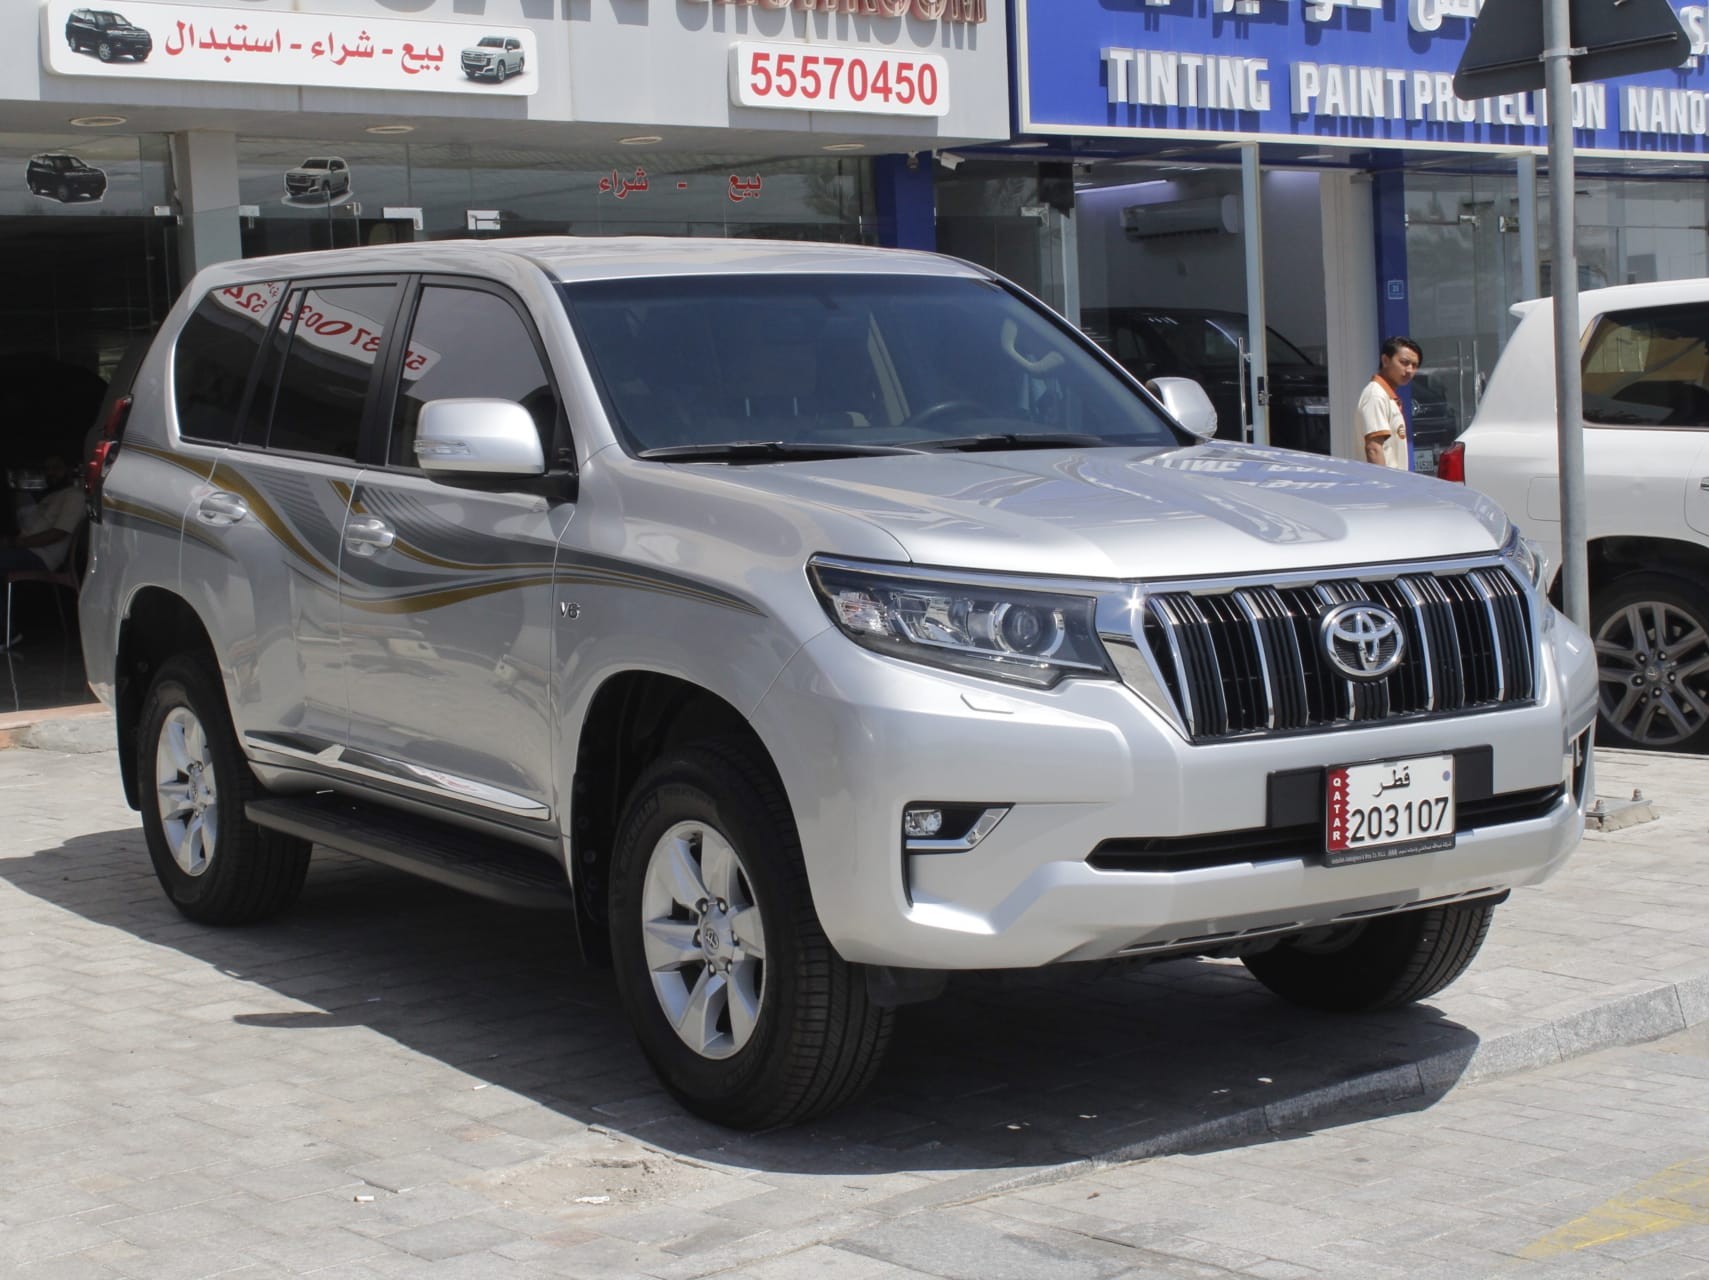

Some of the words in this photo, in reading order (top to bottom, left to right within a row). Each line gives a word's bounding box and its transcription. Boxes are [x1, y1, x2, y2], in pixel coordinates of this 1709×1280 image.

[165, 20, 281, 63] استبدال
[311, 30, 374, 65] شراء
[401, 42, 444, 74] بيع
[750, 52, 938, 105] 55570450
[1101, 47, 1270, 111] TINTING
[598, 167, 648, 199] شراء
[728, 174, 762, 202] بيع
[560, 601, 580, 620] V6
[1372, 766, 1410, 798] قطر
[1332, 777, 1342, 841] QATAR
[1350, 796, 1449, 842] 203107
